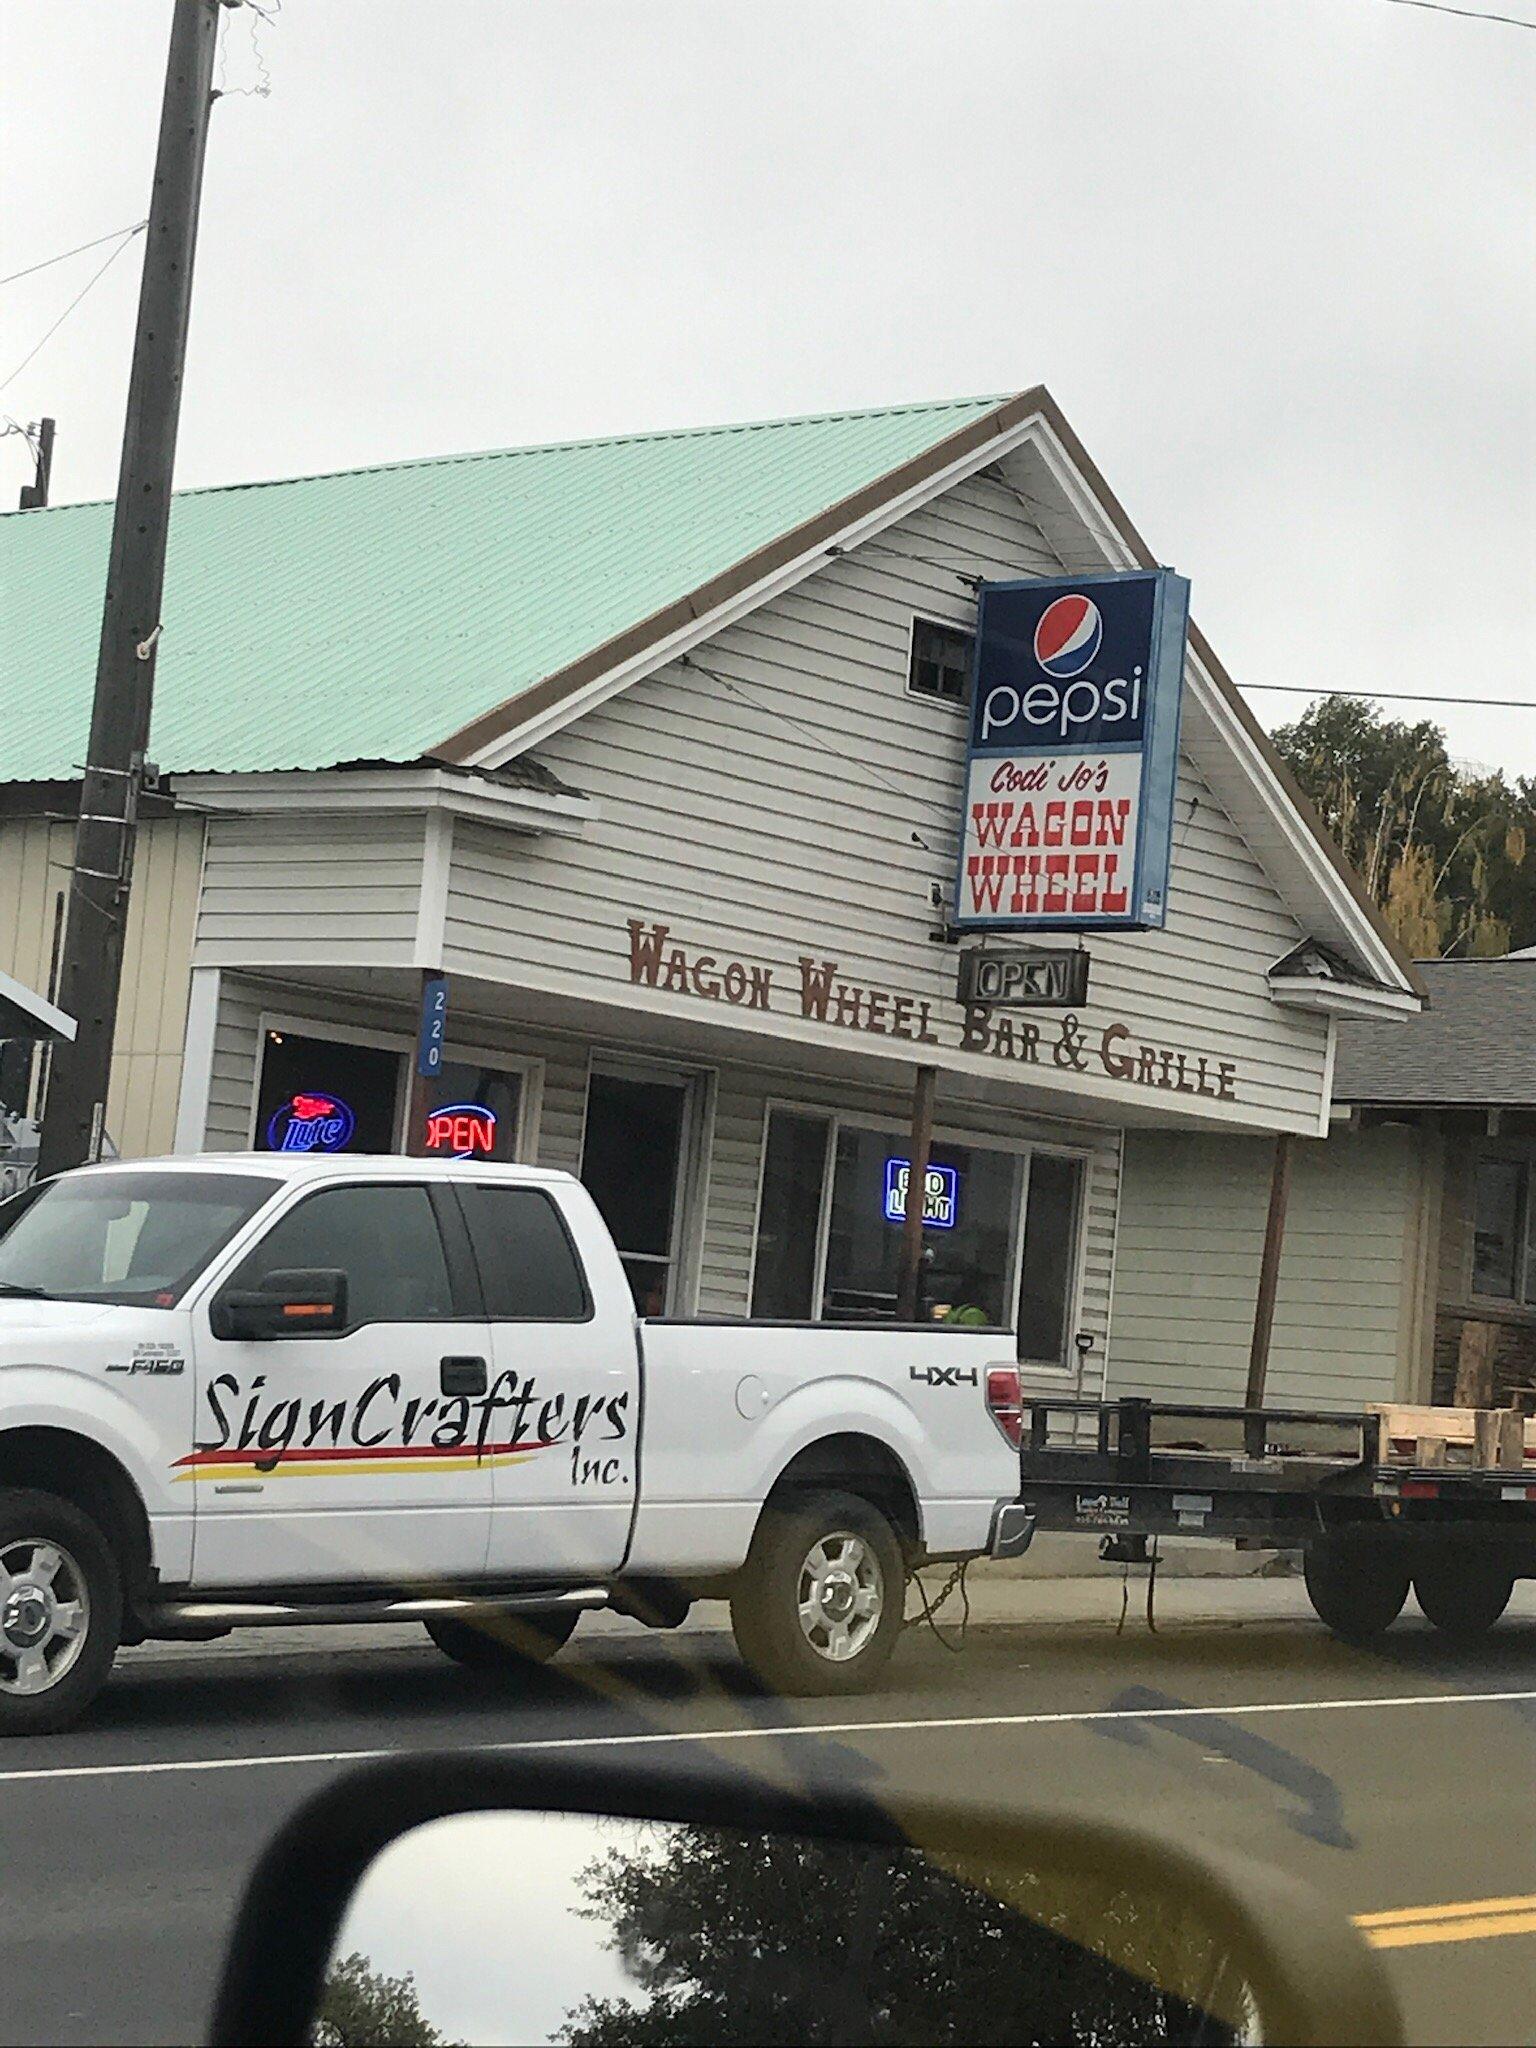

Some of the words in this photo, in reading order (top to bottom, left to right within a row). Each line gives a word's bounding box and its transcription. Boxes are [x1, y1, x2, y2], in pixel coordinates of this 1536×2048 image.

[981, 665, 1142, 740] pepsi
[990, 760, 1056, 793] Codi
[1058, 759, 1109, 793] Jo's
[972, 799, 1130, 848] WAGON
[967, 854, 1128, 913] WHEEL
[977, 960, 1069, 998] OPEN
[1053, 1013, 1089, 1071] &
[898, 1167, 945, 1196] BD
[889, 1188, 952, 1221] LHT
[197, 1368, 630, 1472] SignCrafters
[571, 1446, 630, 1486] Inc.
